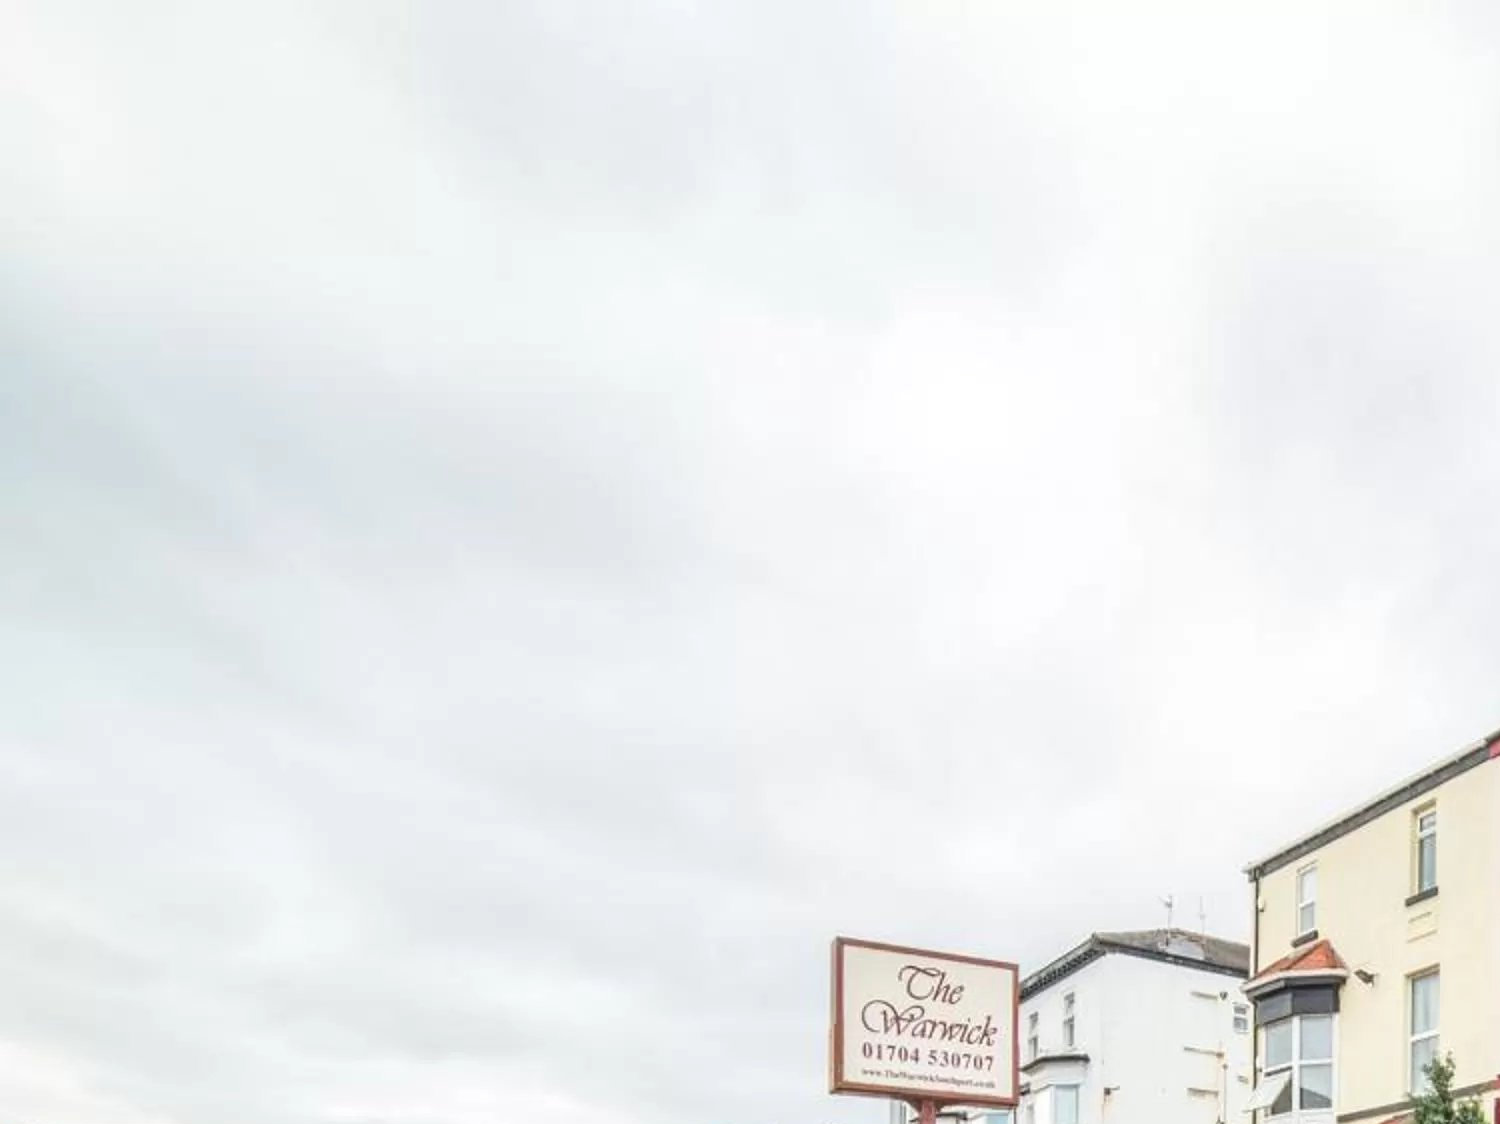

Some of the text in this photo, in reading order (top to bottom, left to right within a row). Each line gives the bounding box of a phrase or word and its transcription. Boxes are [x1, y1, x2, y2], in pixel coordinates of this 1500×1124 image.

[898, 965, 964, 1005] The
[861, 999, 997, 1047] Warwick
[862, 1041, 994, 1072] 01704 530707
